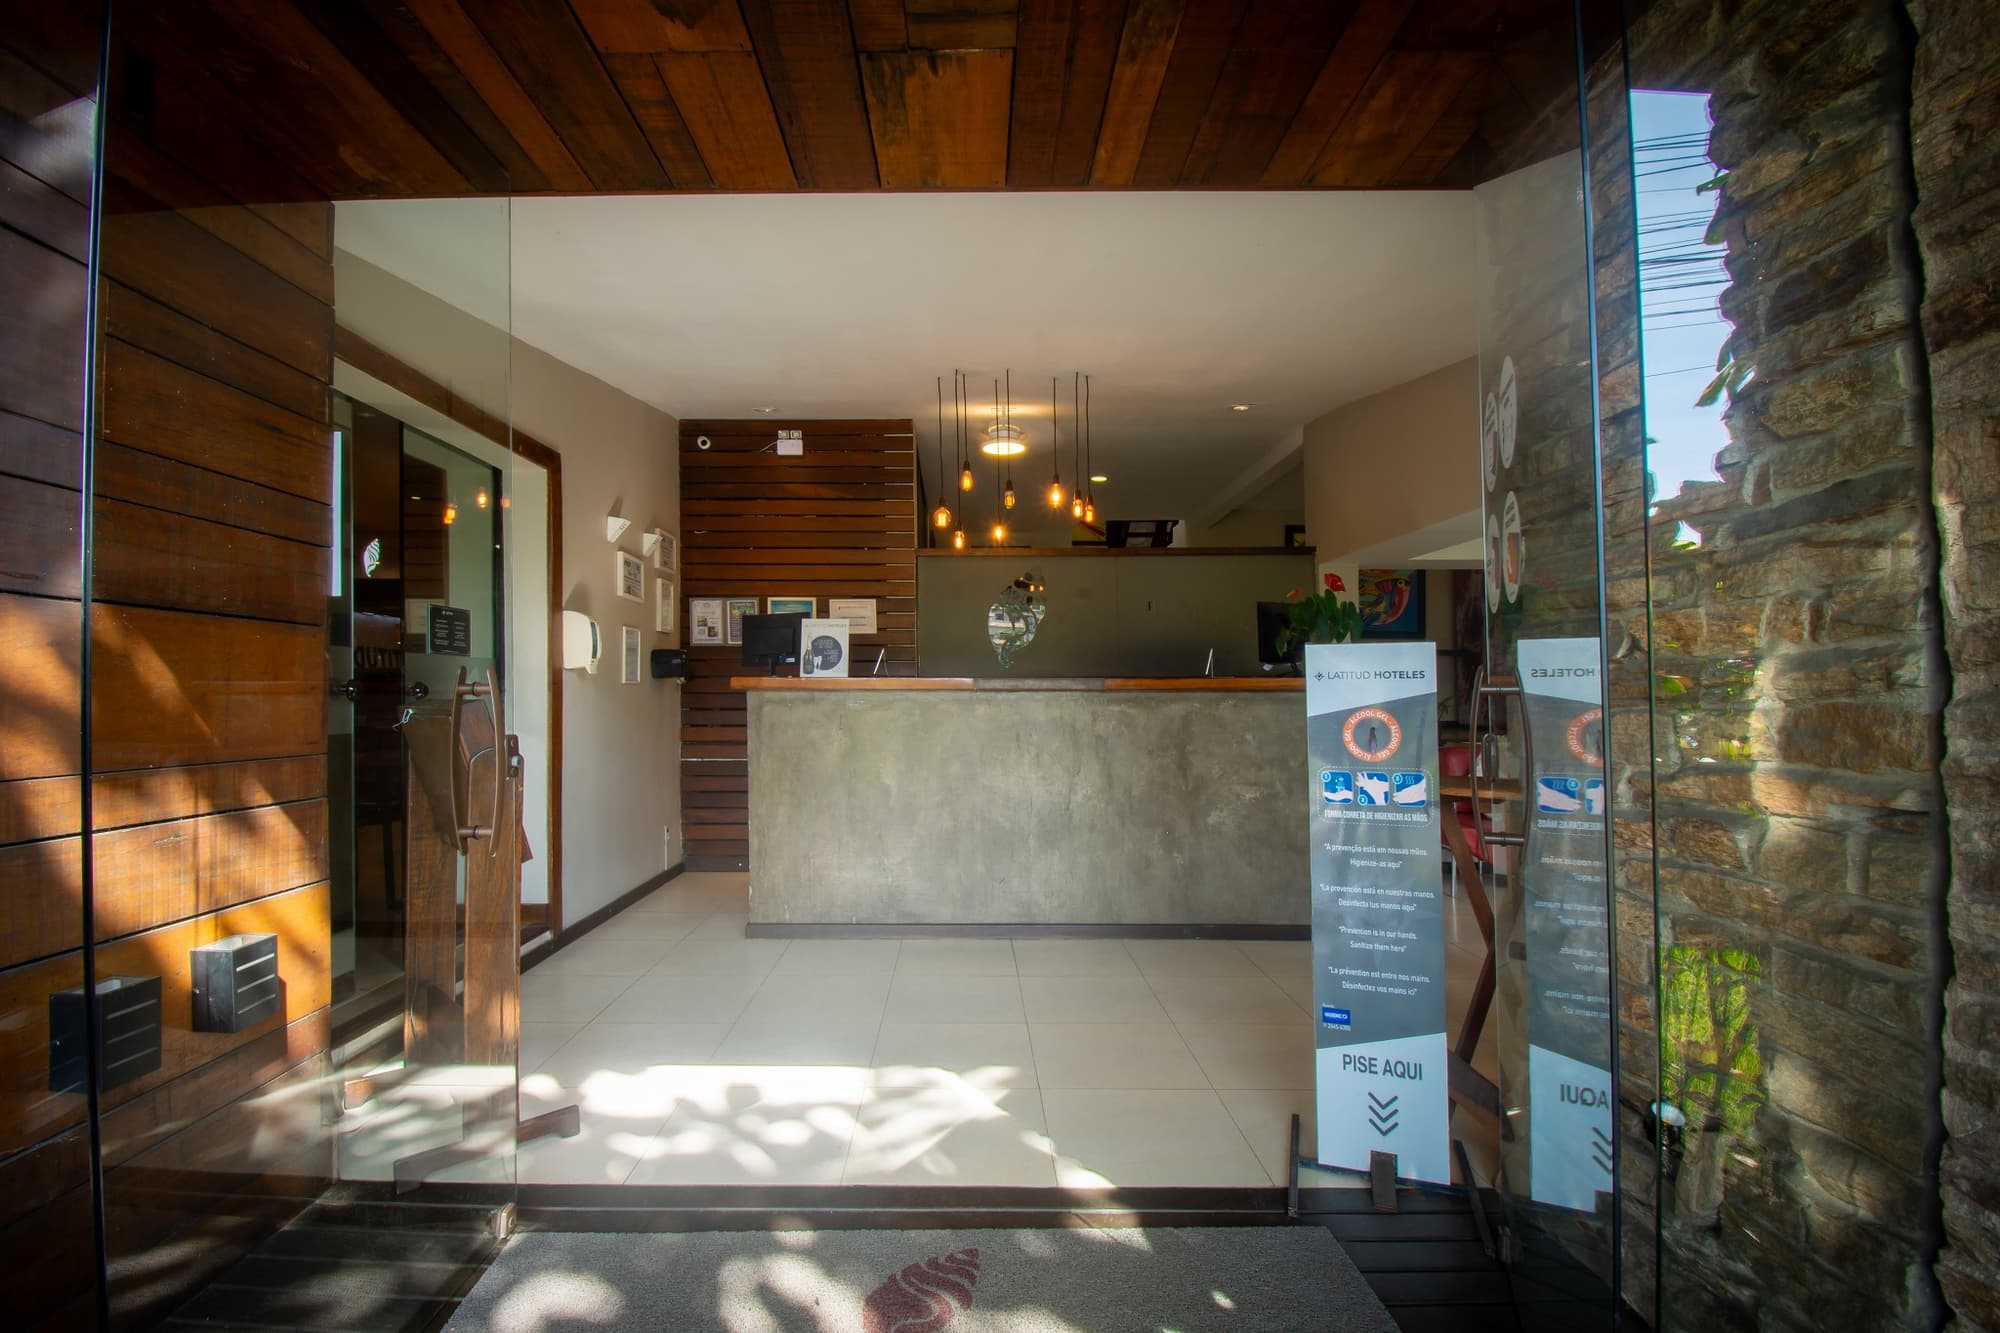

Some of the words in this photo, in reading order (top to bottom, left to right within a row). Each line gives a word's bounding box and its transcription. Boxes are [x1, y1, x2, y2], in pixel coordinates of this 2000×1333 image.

[1327, 671, 1371, 680] LATITUD
[1374, 670, 1426, 679] HOTELES
[1366, 811, 1373, 820] DE
[1403, 813, 1411, 822] AS
[1332, 844, 1361, 854] prevenção
[1363, 844, 1376, 854] está
[1388, 847, 1409, 855] nossas
[1350, 859, 1386, 868] Higienize-as
[1363, 886, 1376, 896] está
[1386, 888, 1412, 897] nuestras
[1338, 898, 1369, 908] Desinfecta
[1370, 899, 1379, 909] tus
[1380, 902, 1401, 910] manos
[1372, 928, 1378, 937] is
[1379, 928, 1385, 937] in
[1386, 930, 1397, 939] our
[1350, 940, 1373, 950] Sanitize
[1374, 942, 1389, 951] them
[1339, 967, 1370, 978] prévention
[1371, 969, 1380, 979] est
[1381, 971, 1397, 981] entre
[1398, 973, 1409, 982] nos
[1342, 980, 1376, 991] Désinfectez
[1377, 985, 1387, 993] vos
[1388, 986, 1407, 996] mains
[1342, 1053, 1378, 1075] PISE
[1382, 1058, 1423, 1081] AQUI
